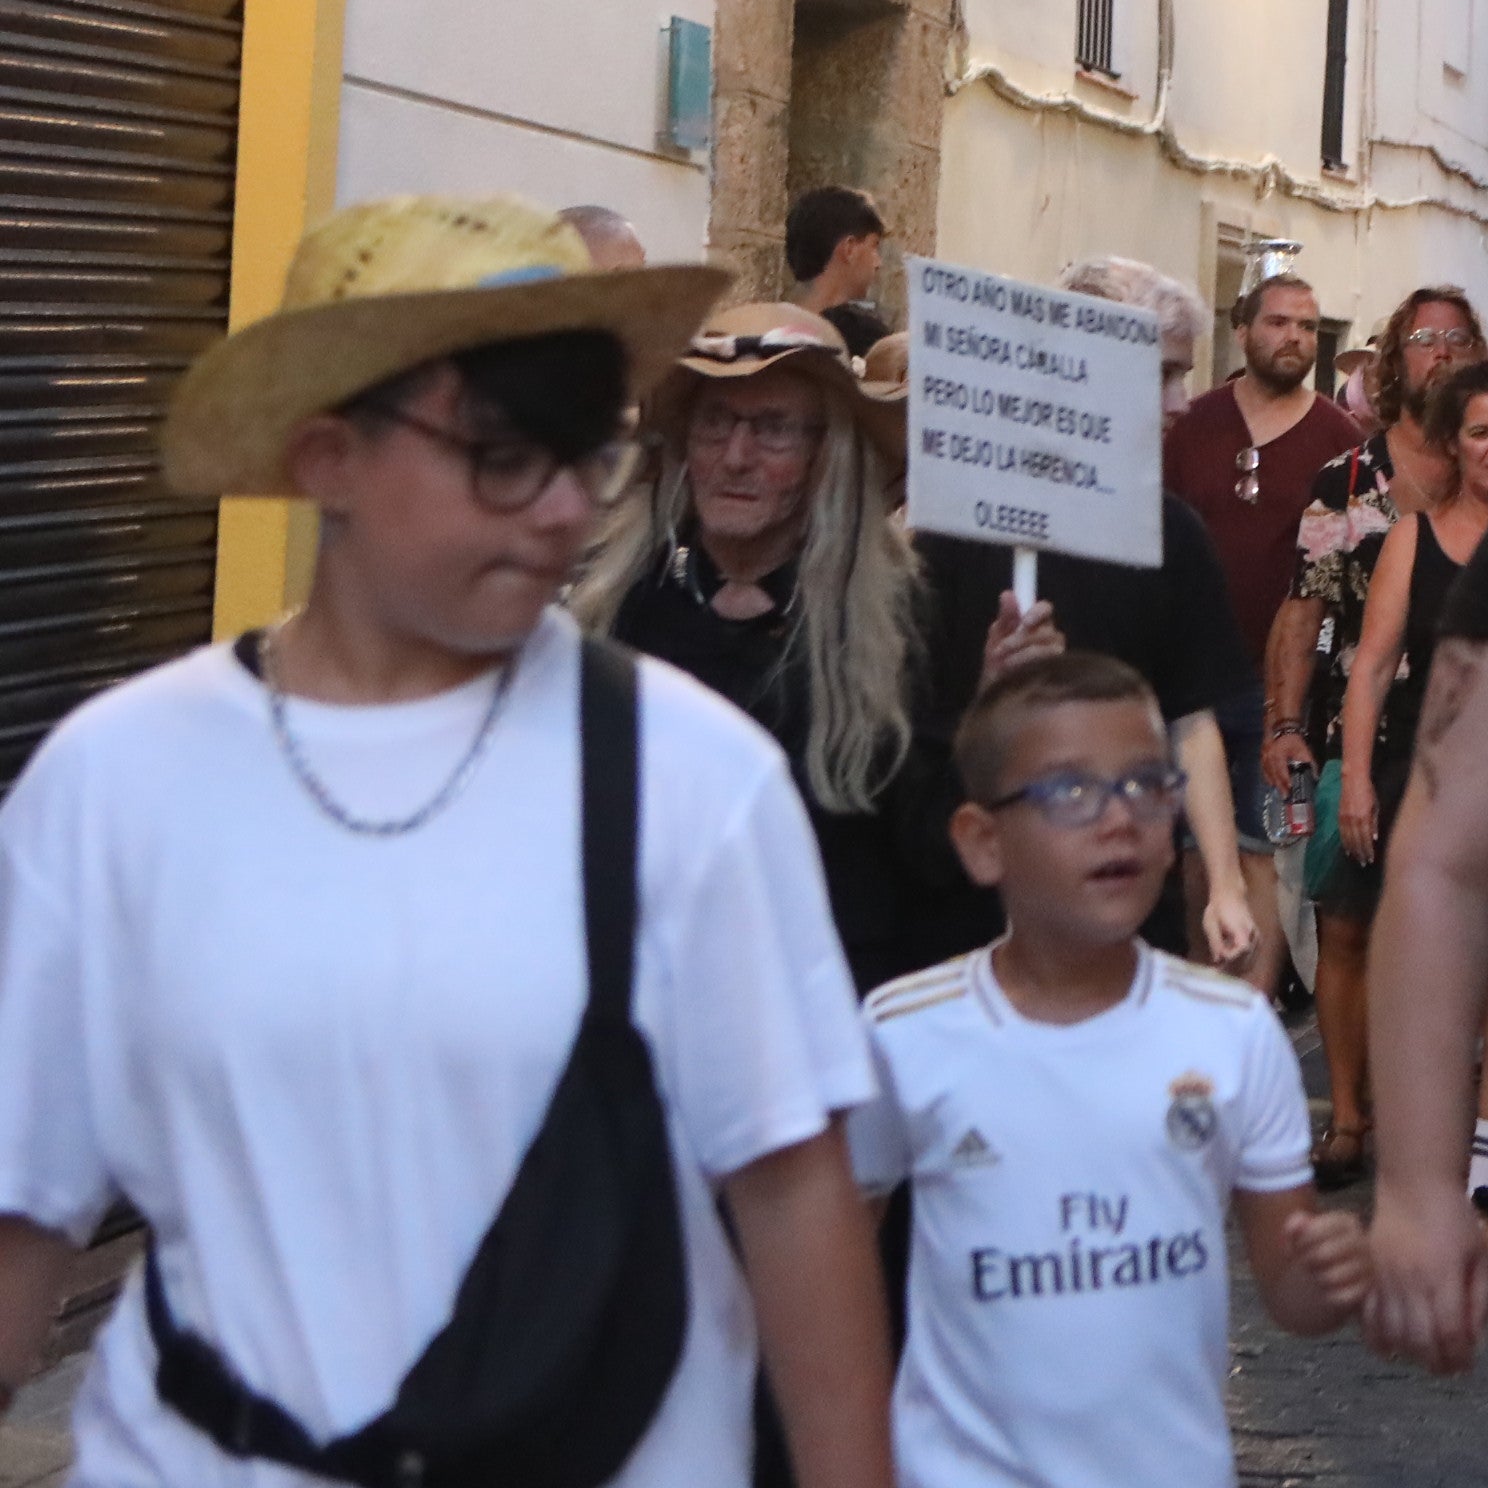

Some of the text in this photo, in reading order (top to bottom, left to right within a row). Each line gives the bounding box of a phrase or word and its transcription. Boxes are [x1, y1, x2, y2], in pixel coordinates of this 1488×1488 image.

[922, 266, 969, 302] OTRO
[972, 275, 1004, 312] AÑO
[1010, 291, 1045, 323] MAS
[1050, 302, 1070, 328] ME
[923, 320, 941, 349] MI
[946, 324, 1011, 365] SEÑORA
[923, 375, 1112, 444] PERO LO MEJOR ES QUE
[922, 426, 946, 459] ME
[950, 433, 993, 468] DEJO
[997, 445, 1016, 471] LA
[1059, 1191, 1130, 1236] Fly
[969, 1228, 1209, 1304] Emirates
